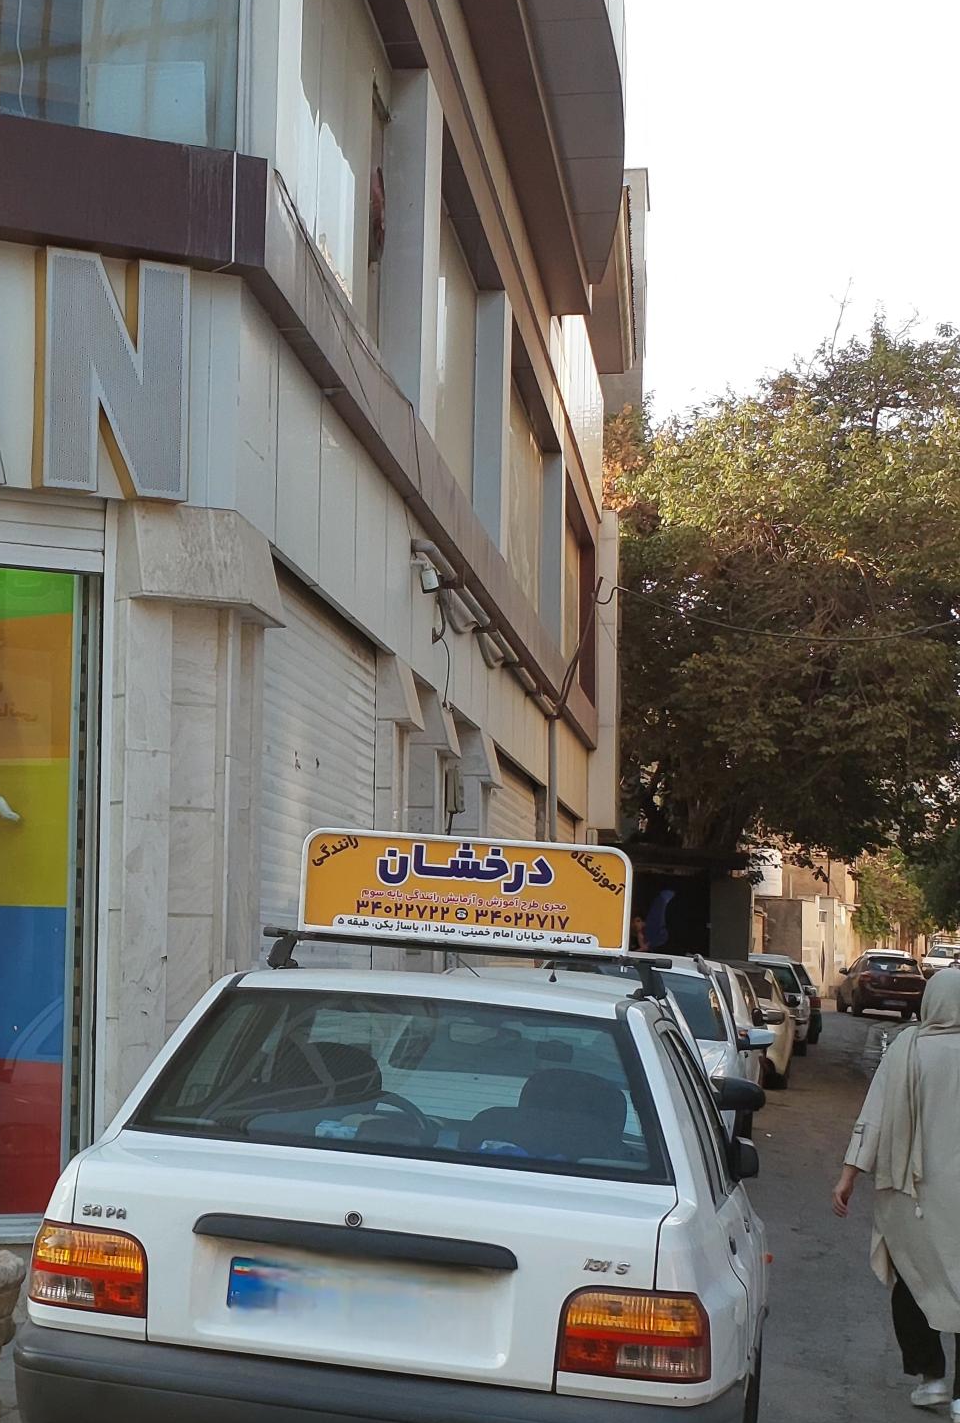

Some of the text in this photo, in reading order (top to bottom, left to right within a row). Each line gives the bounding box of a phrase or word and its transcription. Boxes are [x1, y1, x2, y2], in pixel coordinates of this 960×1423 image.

[312, 835, 359, 866] رانندگی
[378, 842, 554, 894] درخشان
[571, 851, 626, 895] آموزشگاه
[361, 889, 567, 912] مجری طرح آموزش و آزمایش رانندگی پایه سوم
[347, 917, 369, 928] طبقه
[356, 900, 570, 930] ۳۴۰۲۲۷۲۲ ۳۴۰۲۲۷۱۷
[433, 925, 455, 935] میلاد
[492, 929, 513, 939] امام
[516, 932, 544, 942] خیابان
